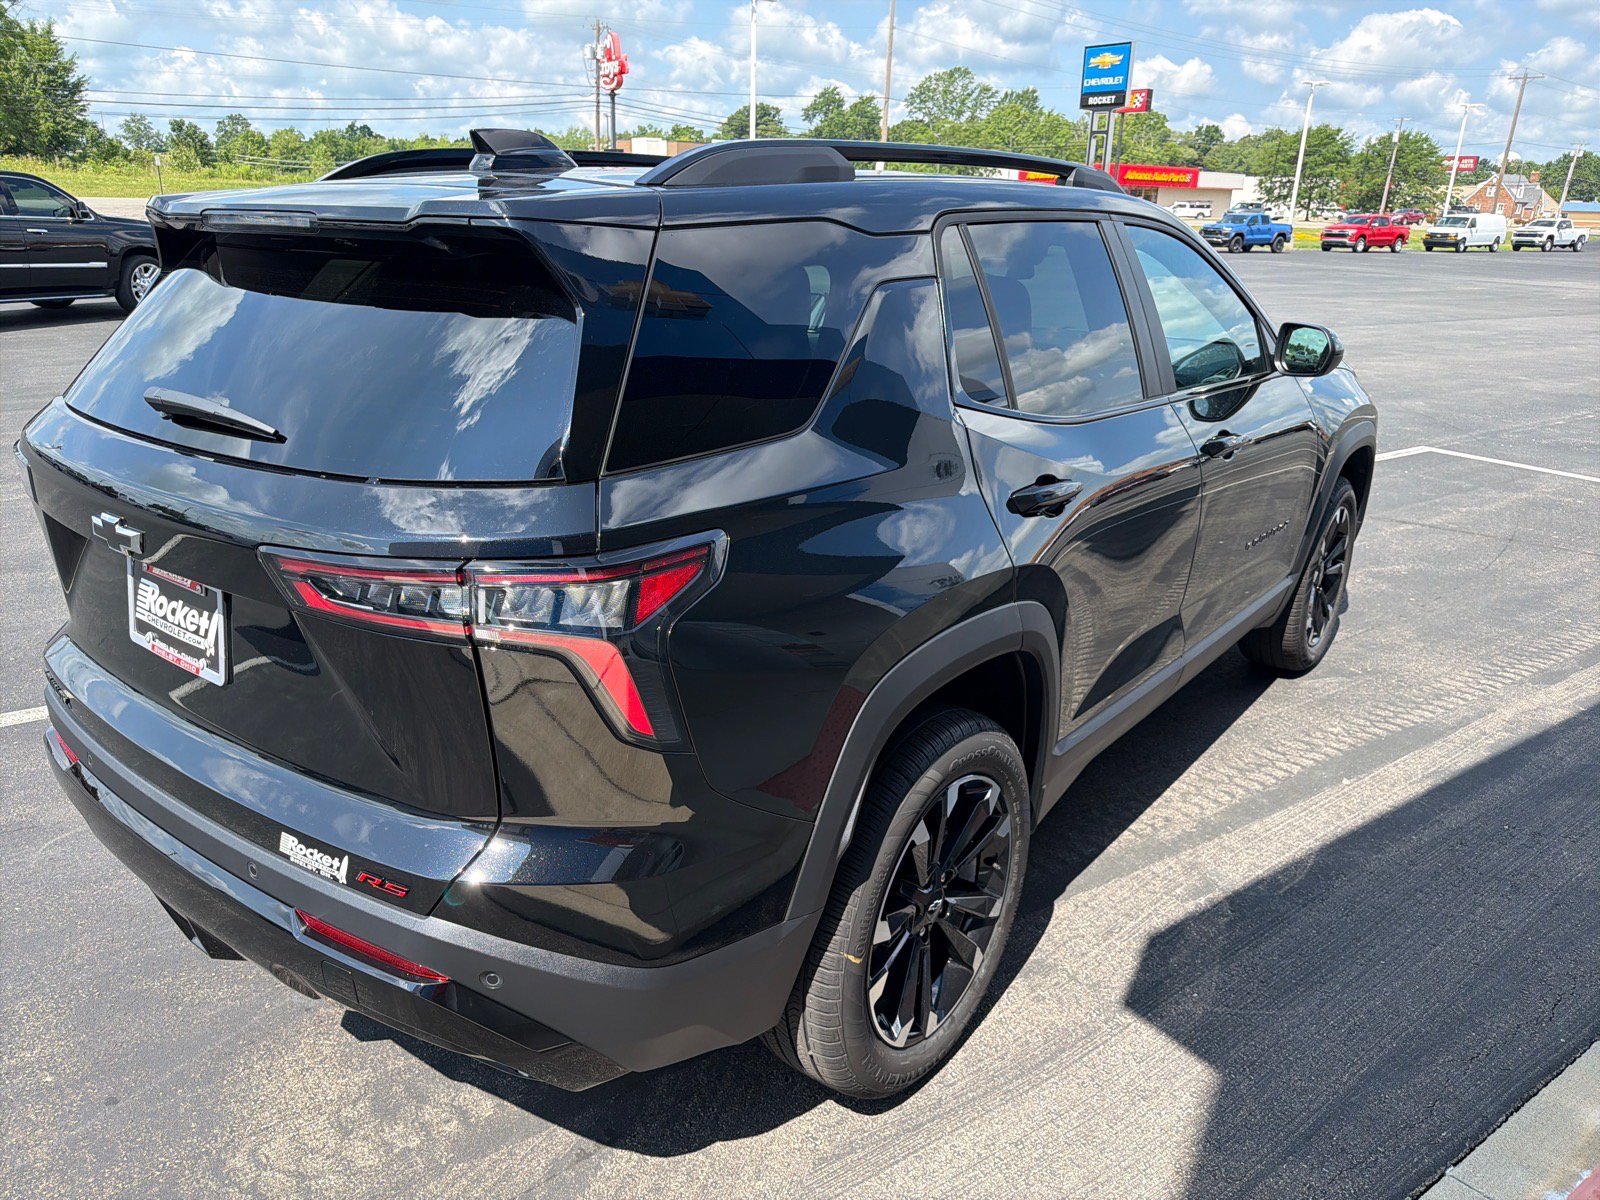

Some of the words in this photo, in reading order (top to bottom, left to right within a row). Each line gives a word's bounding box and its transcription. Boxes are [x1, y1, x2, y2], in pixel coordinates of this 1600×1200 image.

[1084, 76, 1124, 87] CHEVROLET
[1088, 95, 1116, 105] ROCKET
[1153, 172, 1168, 182] Auto
[1168, 173, 1187, 183] Parts
[279, 831, 341, 871] Rocket
[356, 870, 410, 898] RS
